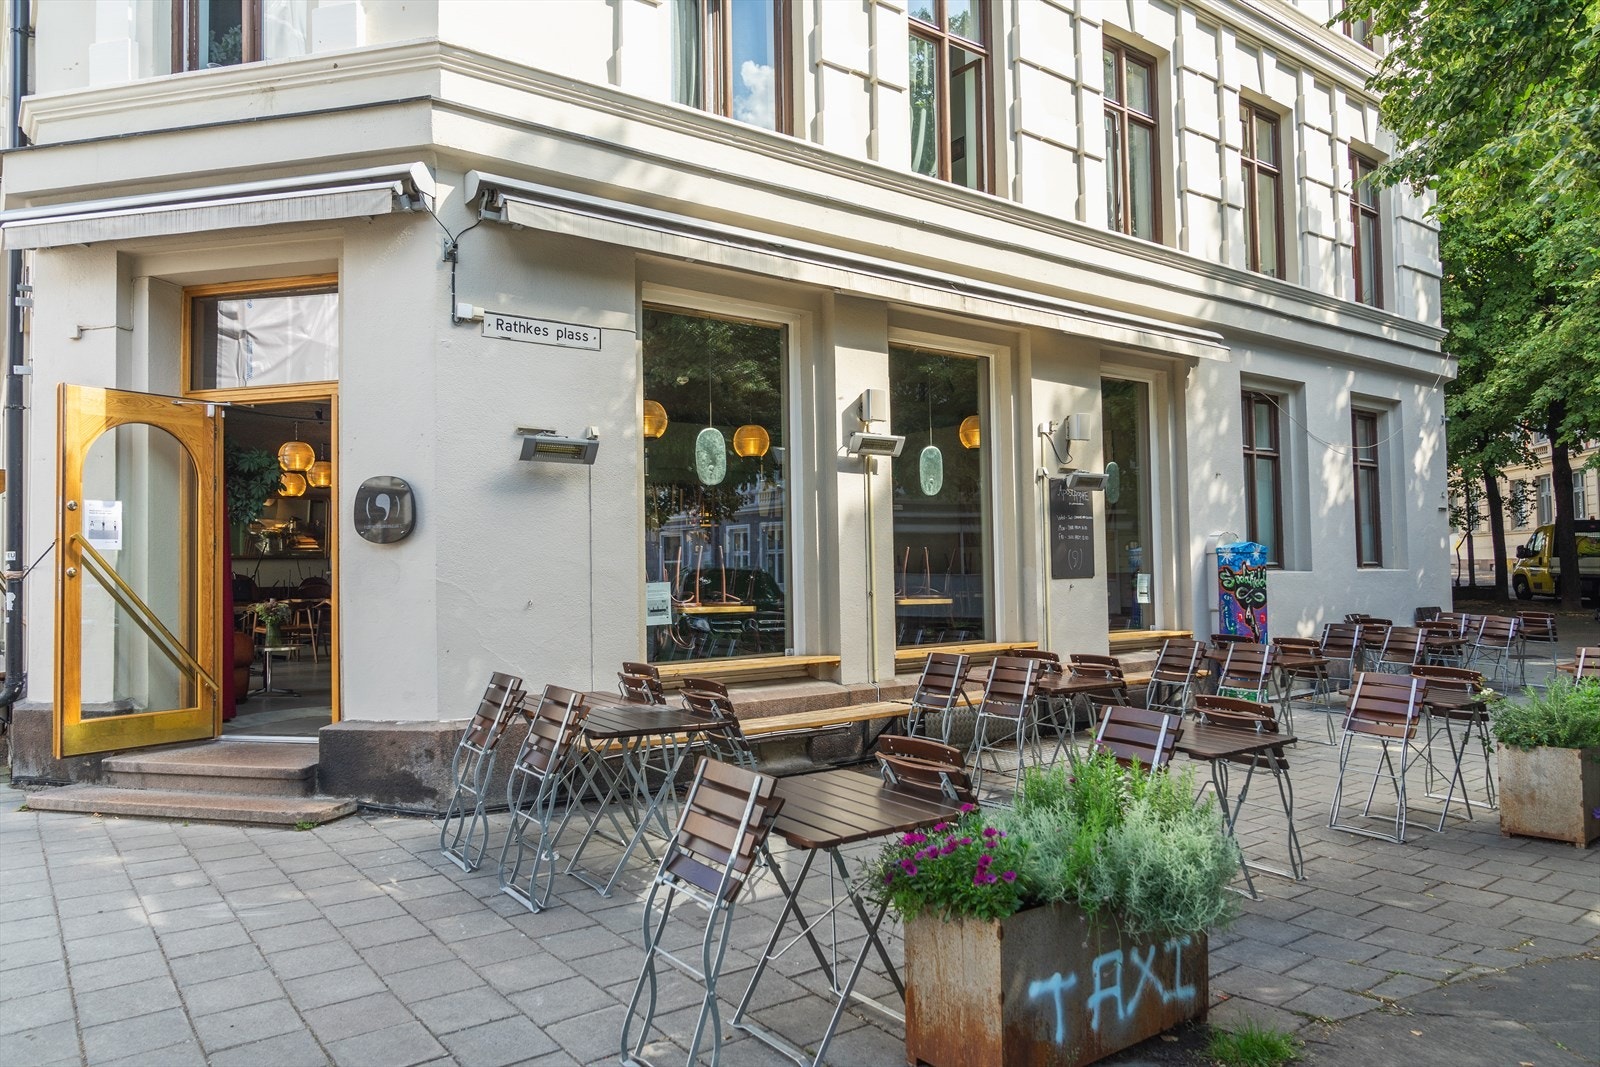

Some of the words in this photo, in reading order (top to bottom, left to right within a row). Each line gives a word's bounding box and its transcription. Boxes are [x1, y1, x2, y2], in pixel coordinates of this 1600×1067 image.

[496, 318, 549, 336] Rathkes
[556, 327, 589, 341] plass
[1028, 935, 1196, 1046] TAXI
